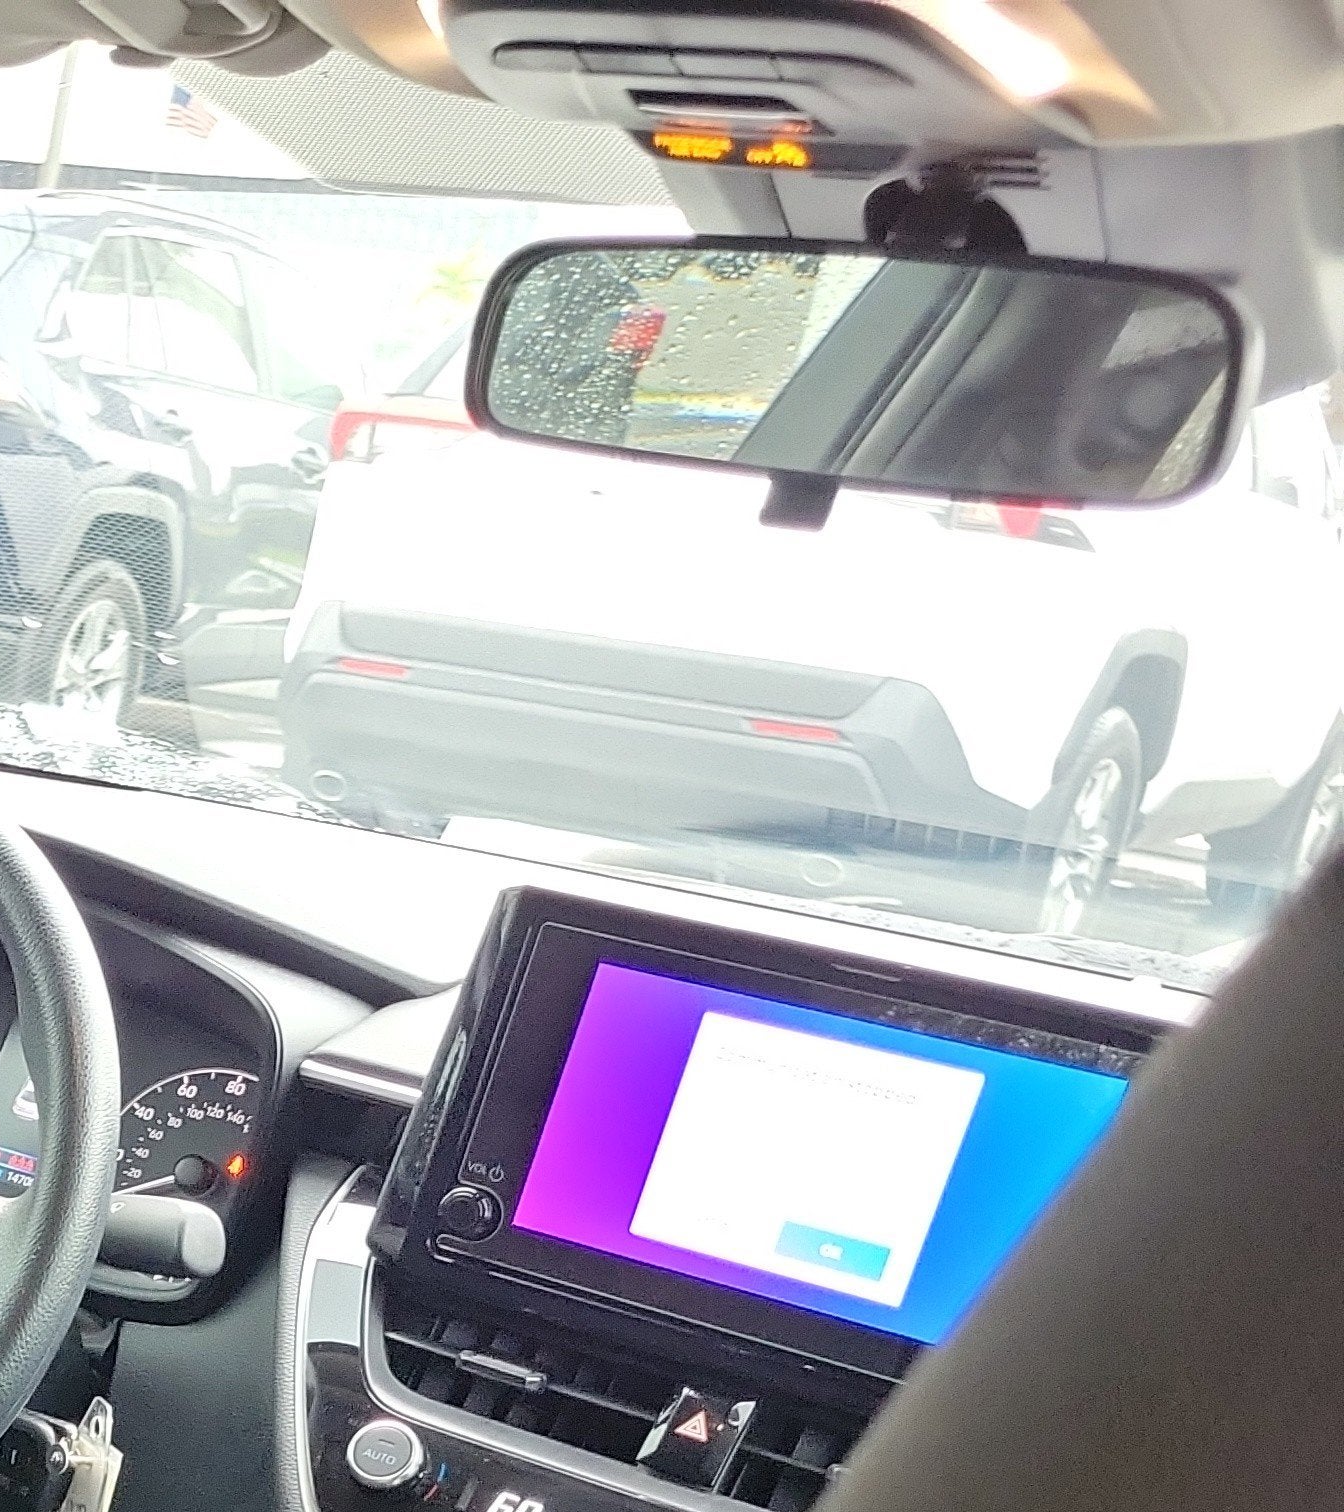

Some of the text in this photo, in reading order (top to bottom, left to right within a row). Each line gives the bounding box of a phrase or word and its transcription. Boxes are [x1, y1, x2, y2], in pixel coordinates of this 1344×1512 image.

[177, 1083, 198, 1098] 60
[225, 1080, 246, 1096] 80
[134, 1105, 155, 1121] 40
[186, 1106, 205, 1120] 100
[206, 1106, 225, 1119] 120
[226, 1111, 245, 1125] 140
[167, 1116, 182, 1128] 80
[148, 1129, 164, 1141] 60
[134, 1147, 150, 1159] 40
[126, 1167, 142, 1179] 20
[468, 1160, 487, 1176] VOL
[362, 1448, 397, 1465] AUTO
